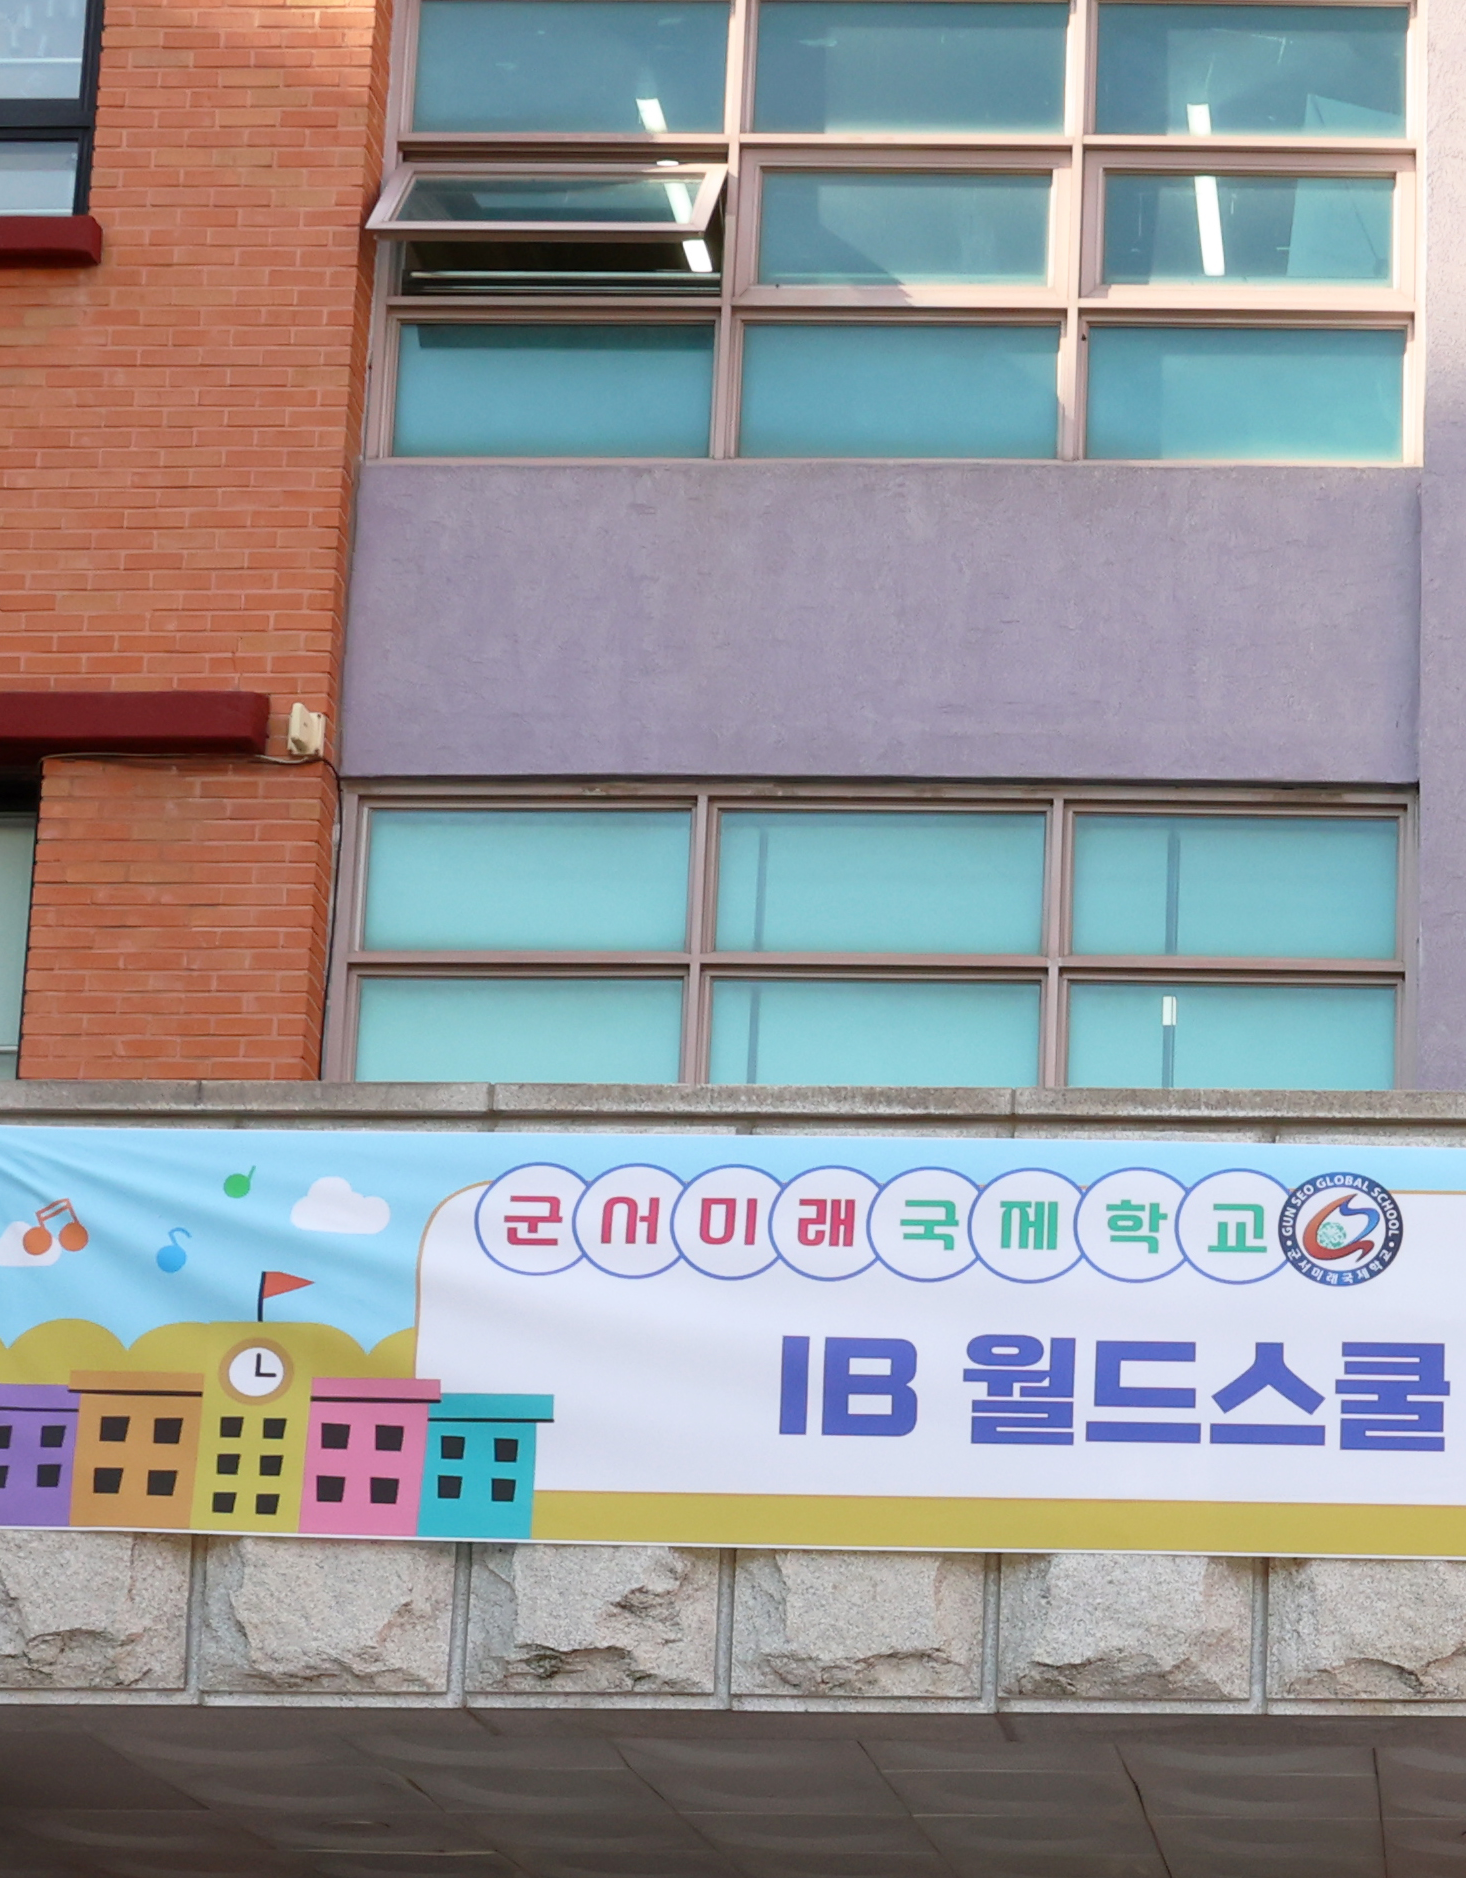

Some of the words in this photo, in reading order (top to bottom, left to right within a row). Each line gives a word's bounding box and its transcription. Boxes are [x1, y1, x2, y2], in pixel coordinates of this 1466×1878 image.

[503, 1195, 1267, 1255] 군서미래국제학교
[1281, 1206, 1297, 1237] GUN
[1291, 1183, 1314, 1206] SEO
[1316, 1174, 1369, 1192] GLOBAL
[1370, 1186, 1400, 1237] SCHOOL
[1287, 1248, 1393, 1285] 군서미래국제학교
[778, 1335, 919, 1437] IB
[962, 1334, 1451, 1452] 월드스쿨
